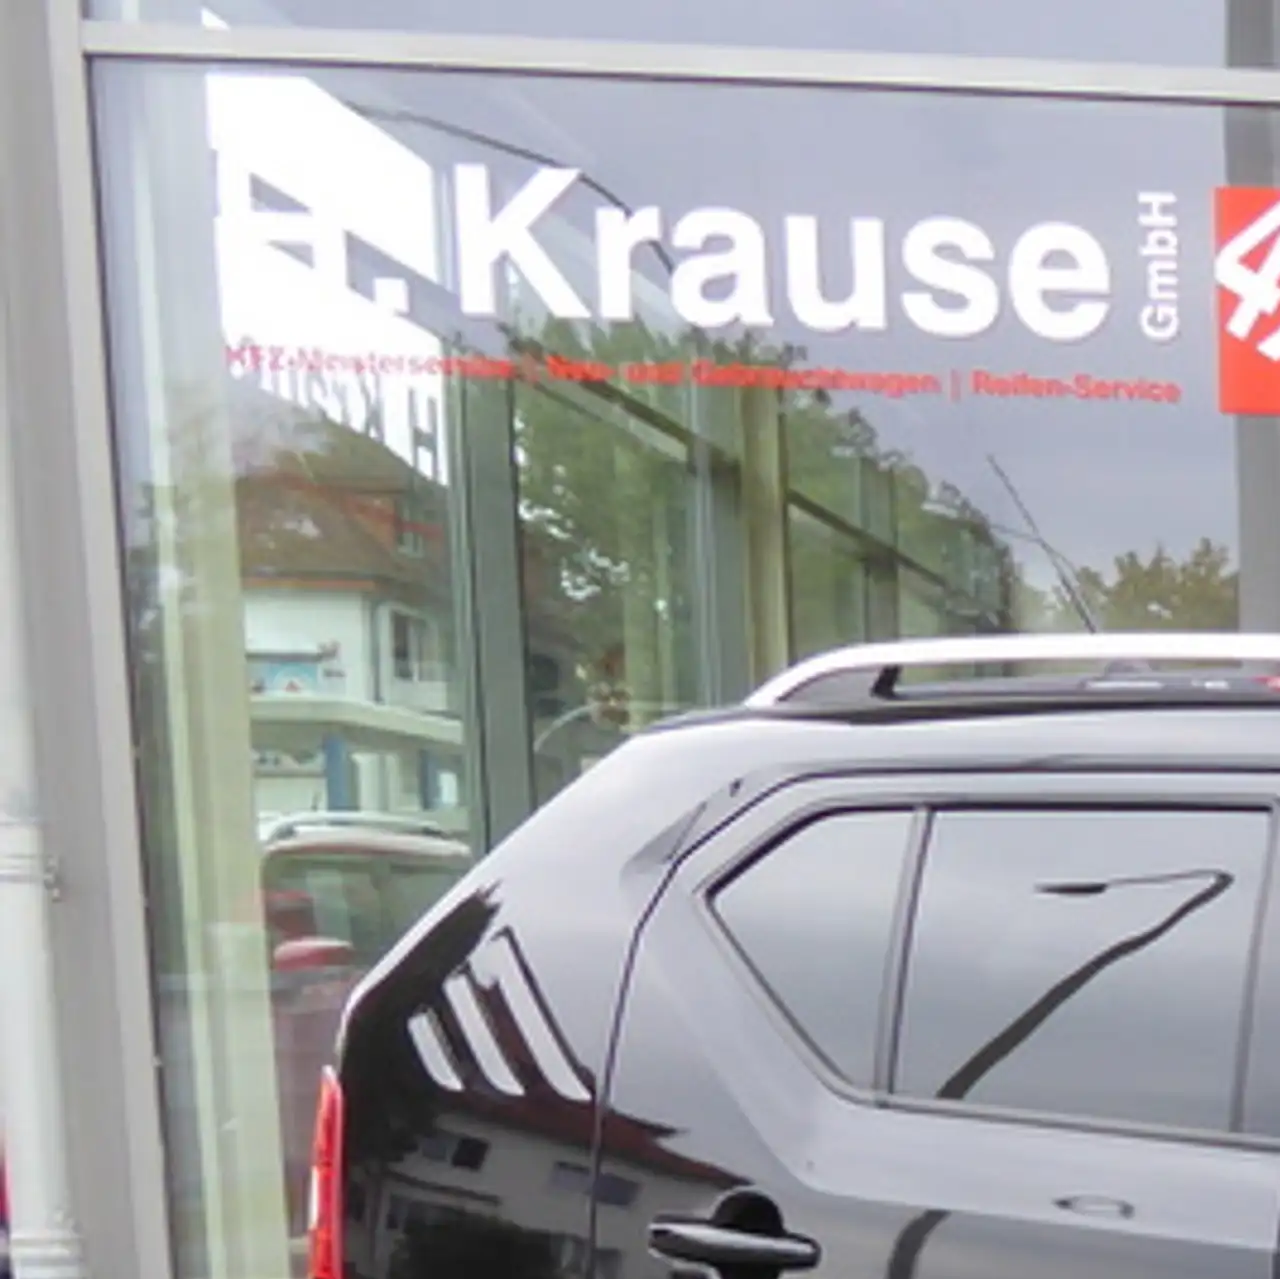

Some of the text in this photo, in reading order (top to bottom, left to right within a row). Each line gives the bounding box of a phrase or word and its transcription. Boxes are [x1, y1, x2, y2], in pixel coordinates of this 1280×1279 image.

[453, 162, 1111, 342] Krause
[1137, 190, 1180, 341] GmbH
[970, 368, 1183, 404] Reifen-Service
